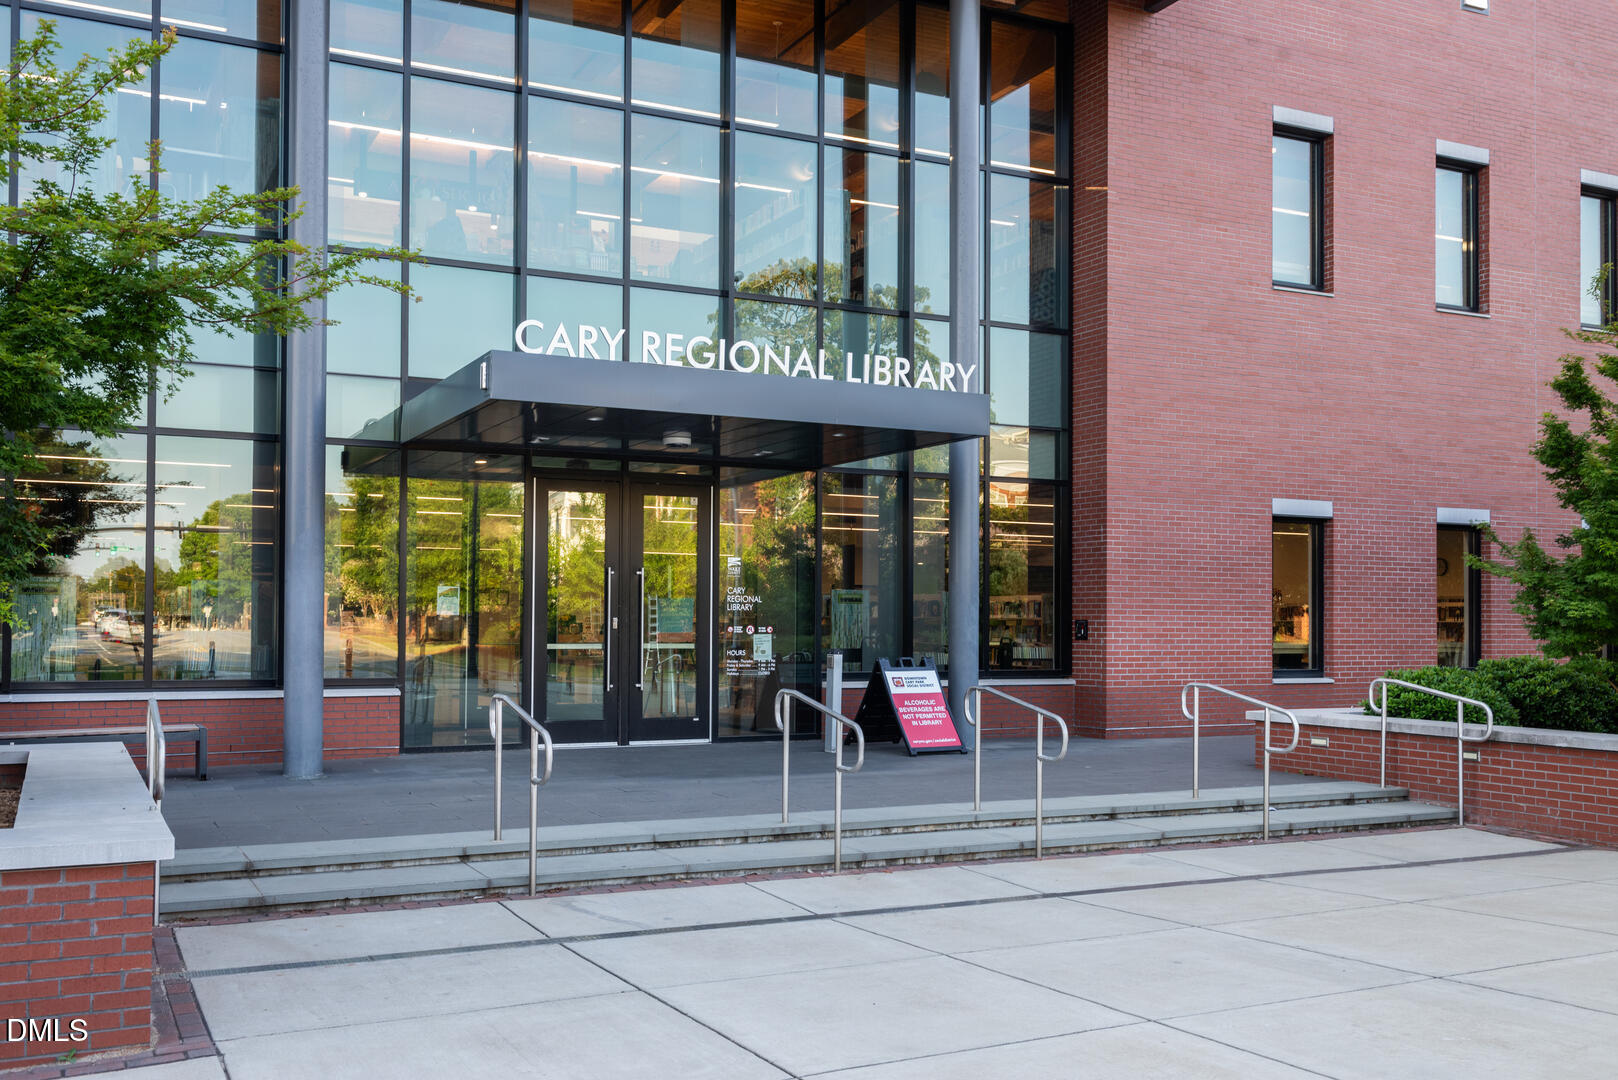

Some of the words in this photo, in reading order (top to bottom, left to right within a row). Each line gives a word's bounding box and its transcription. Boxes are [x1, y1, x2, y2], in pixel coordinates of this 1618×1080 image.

[514, 318, 626, 362] CARY
[641, 330, 836, 381] REGIONAL
[846, 351, 977, 393] LIBRARY
[727, 587, 746, 595] CARY
[727, 595, 762, 603] REGIONAL
[727, 603, 754, 611] LIBRARY
